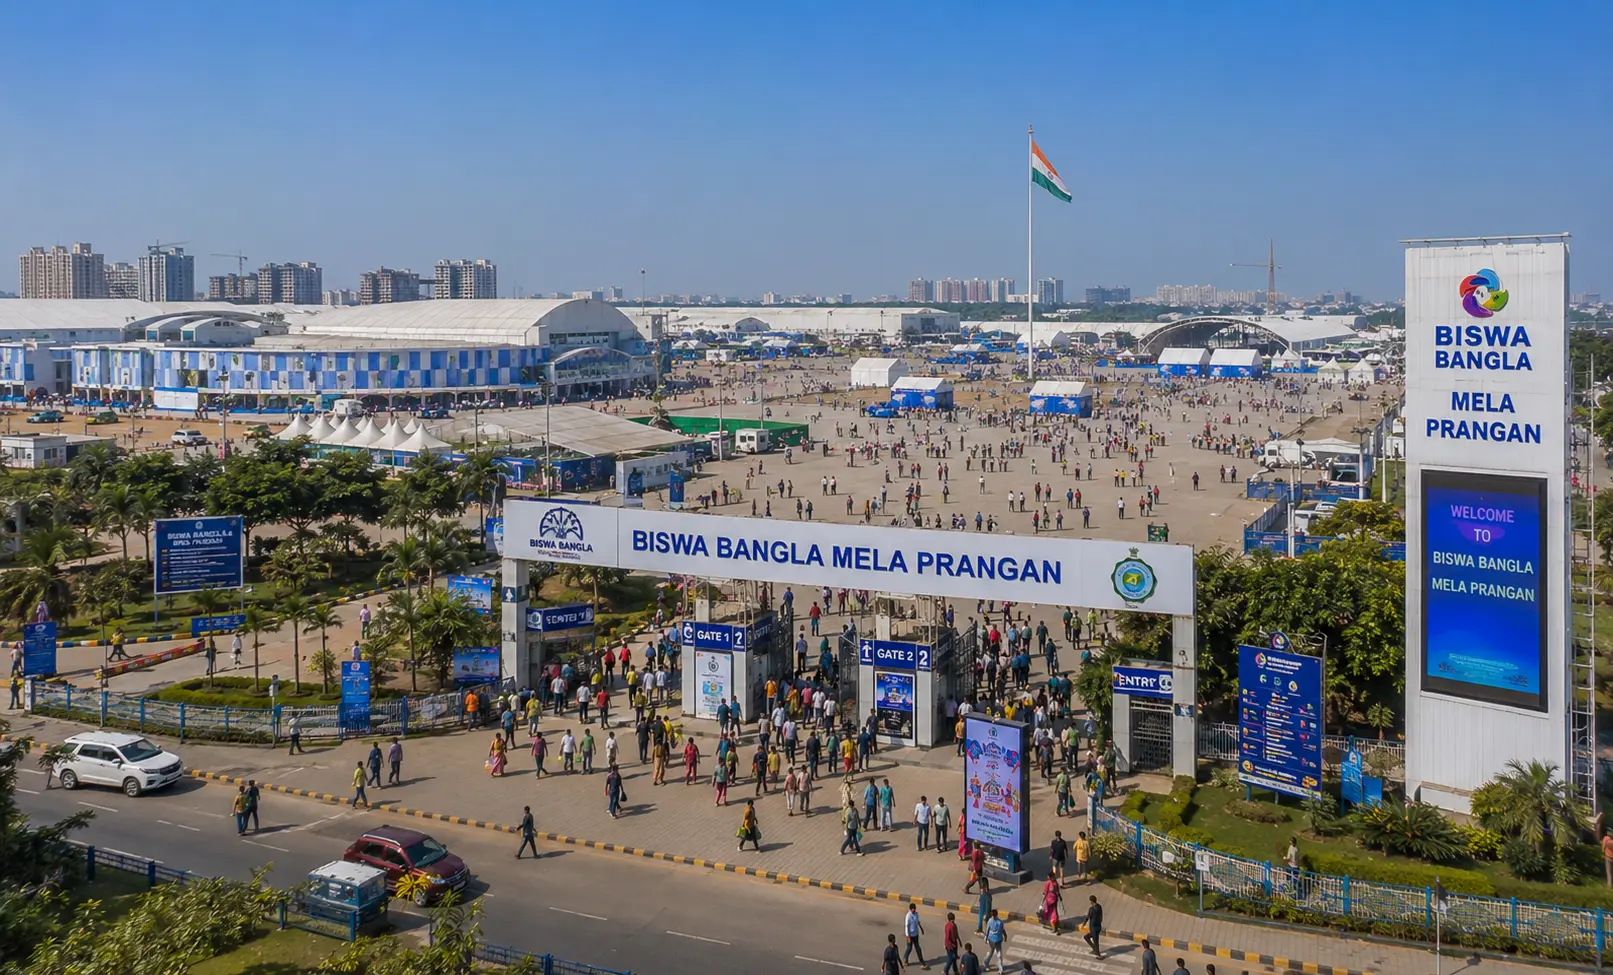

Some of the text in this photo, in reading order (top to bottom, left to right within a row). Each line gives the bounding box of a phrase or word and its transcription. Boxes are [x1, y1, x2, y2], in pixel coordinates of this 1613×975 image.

[1435, 325, 1532, 347] BISWA
[1435, 350, 1533, 371] BANGLA
[1451, 391, 1516, 414] MELA
[1426, 418, 1541, 444] PRANGAN
[1450, 504, 1515, 523] WELCOME
[529, 538, 594, 553] BISWA BANGLA
[1473, 528, 1491, 543] TO
[632, 529, 1062, 585] BISWA BANGLA MELA PRANGAN
[1433, 551, 1534, 575] BISWA BANGLA
[1432, 577, 1535, 602] MELA PRANGAN
[697, 630, 729, 643] GATE 1
[877, 648, 914, 662] GATE 2
[918, 650, 928, 666] 2
